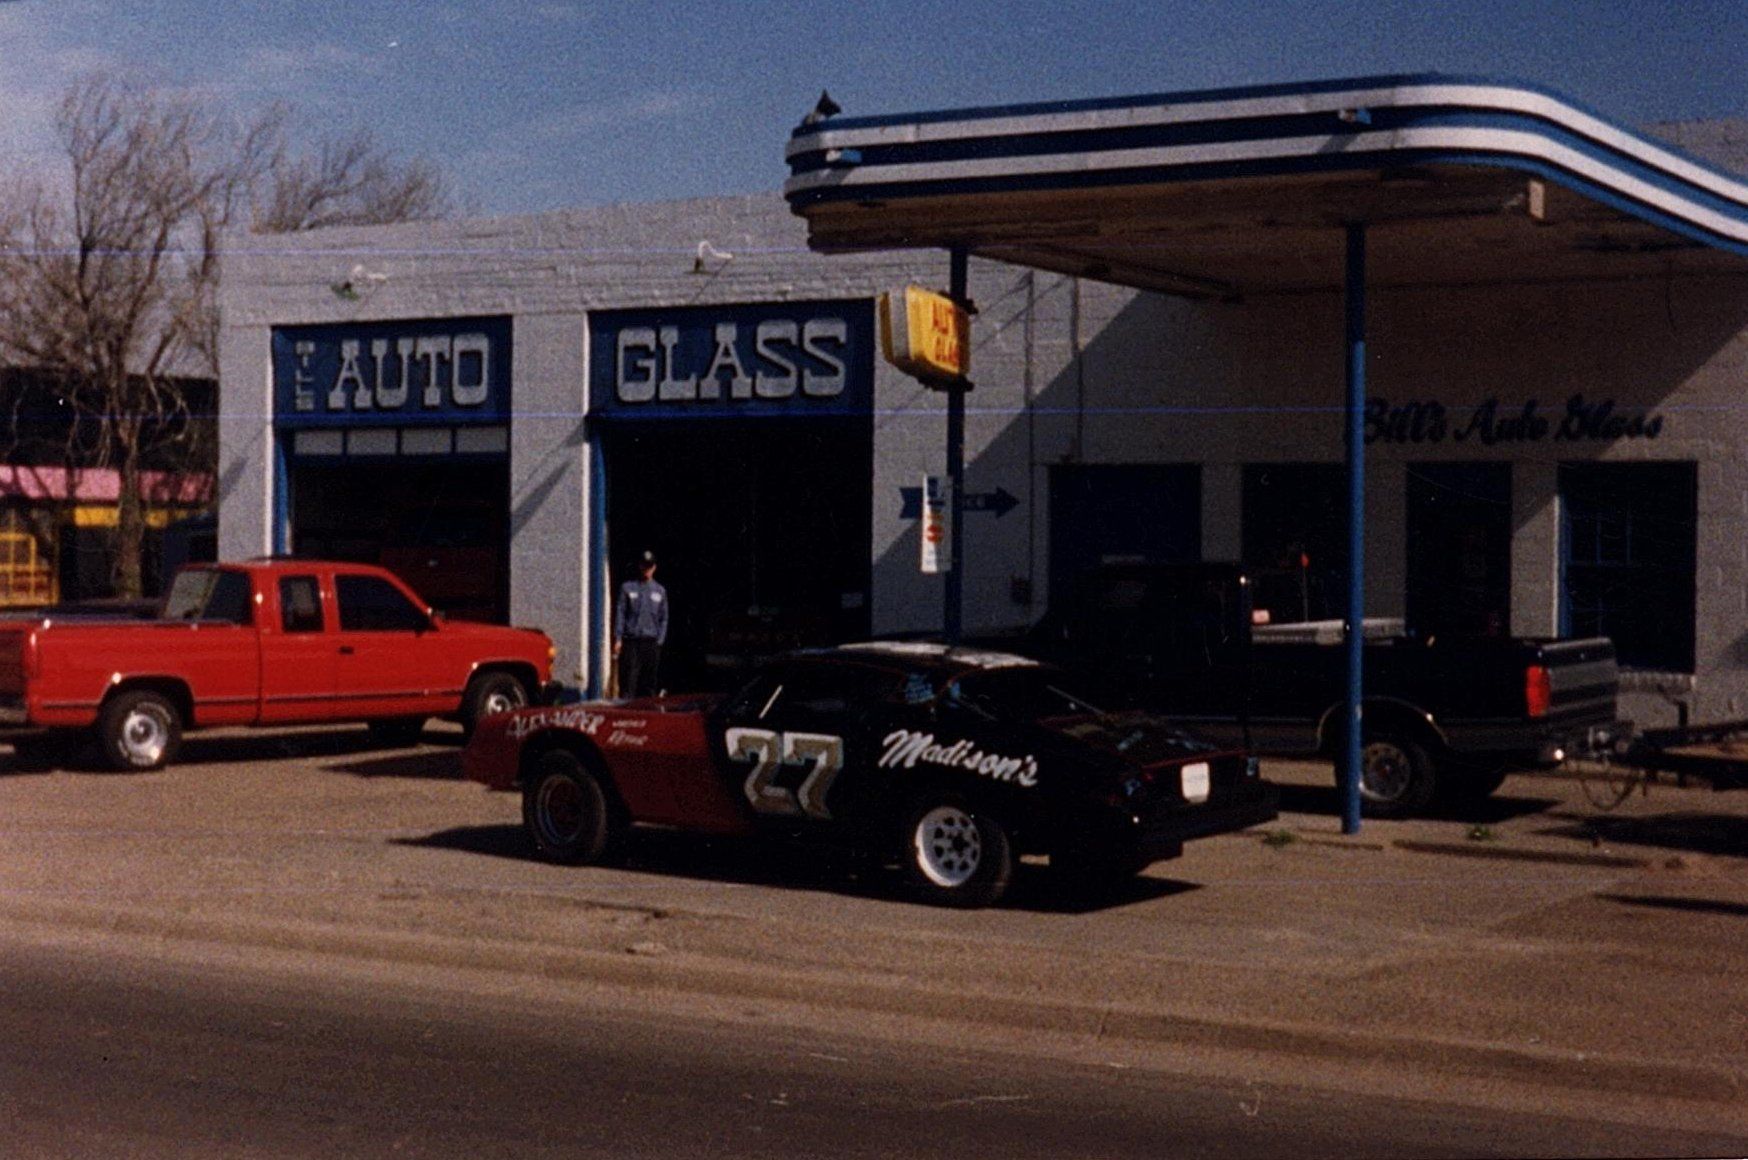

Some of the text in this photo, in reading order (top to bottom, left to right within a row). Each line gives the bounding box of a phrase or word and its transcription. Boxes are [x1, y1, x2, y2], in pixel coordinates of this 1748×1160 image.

[327, 331, 491, 411] AUTO
[615, 317, 848, 403] GLASS
[1454, 396, 1549, 446] Auto
[1554, 391, 1664, 443] Glass
[725, 726, 845, 819] 27
[876, 728, 1039, 788] Madison's
